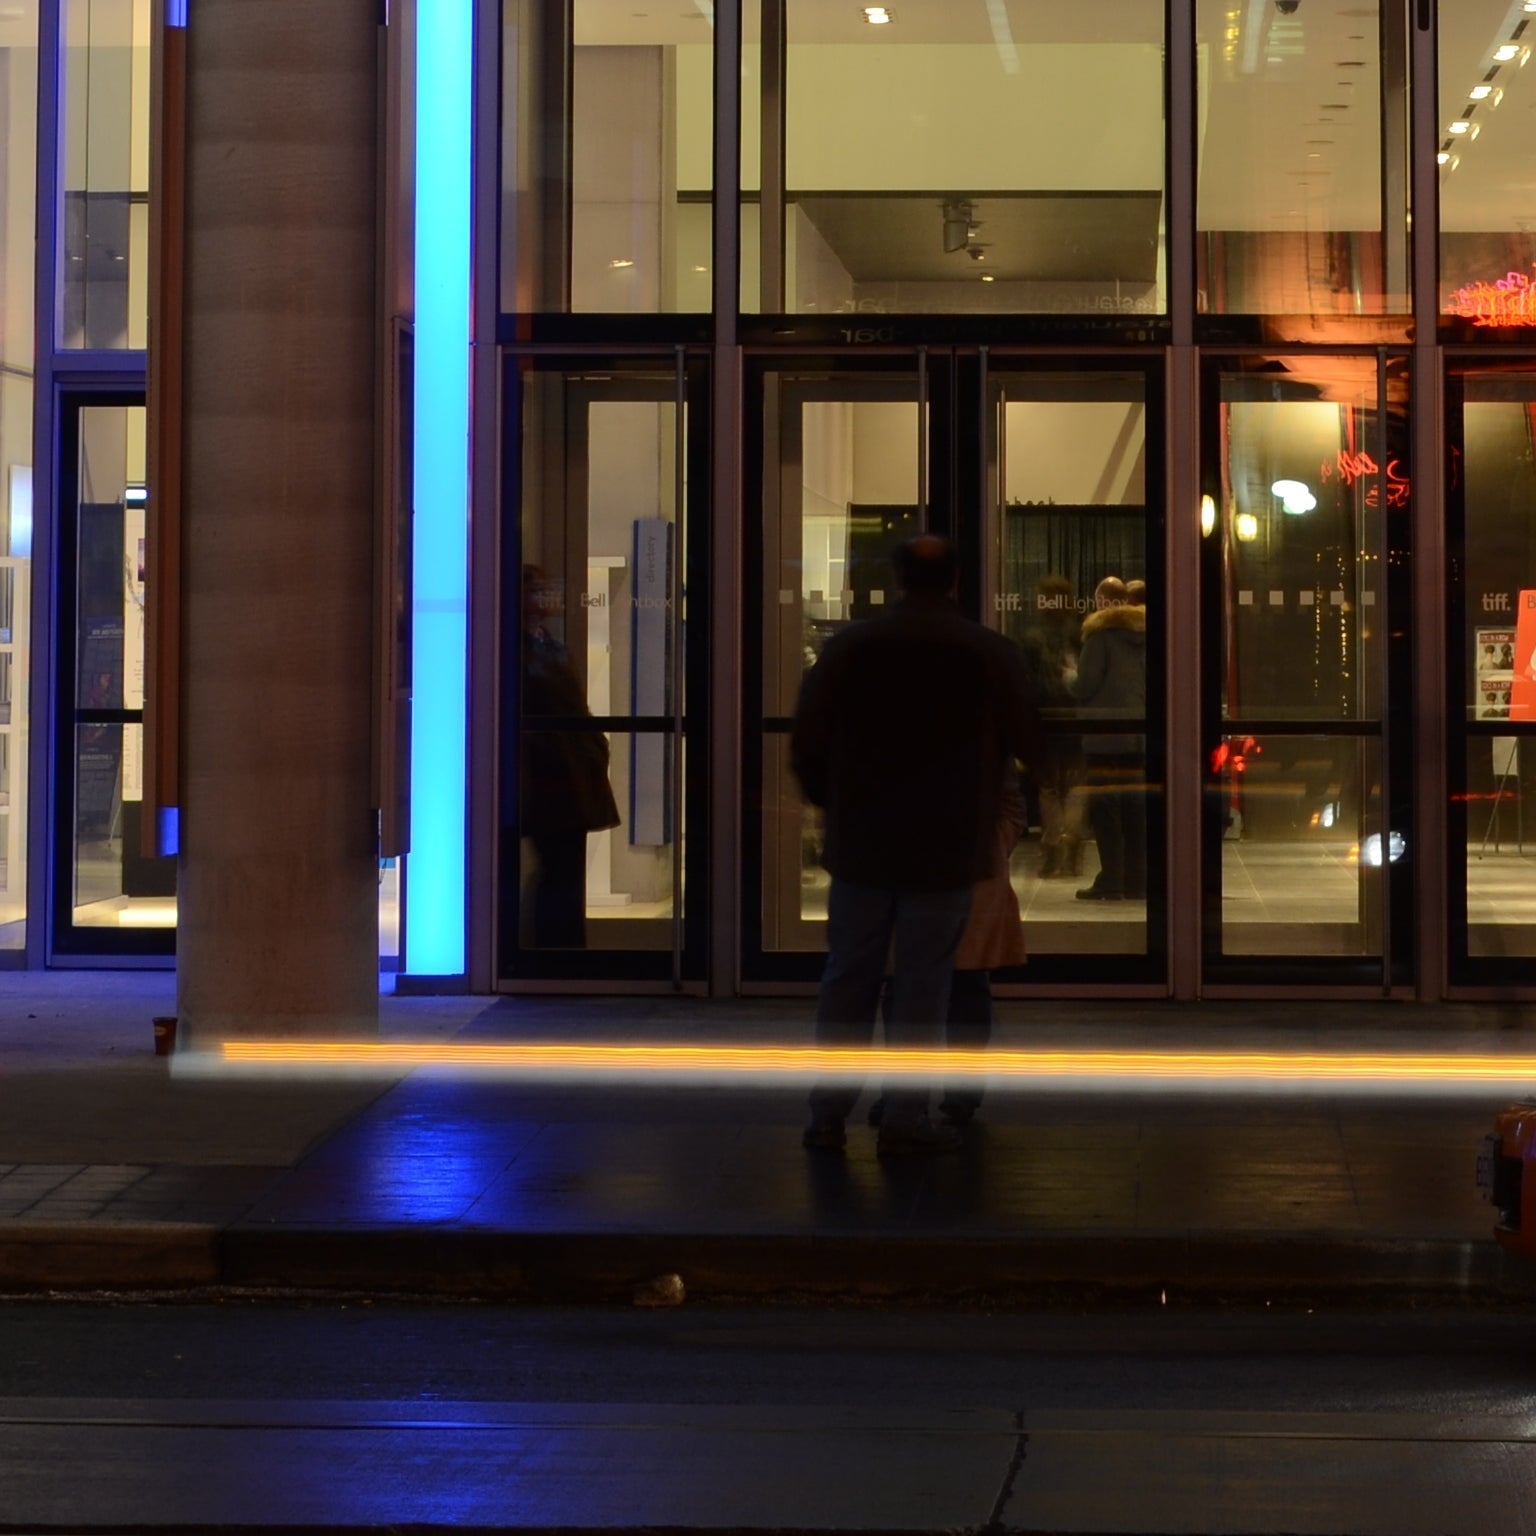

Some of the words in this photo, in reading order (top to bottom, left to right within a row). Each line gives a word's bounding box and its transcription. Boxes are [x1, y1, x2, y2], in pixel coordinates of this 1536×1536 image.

[993, 593, 1022, 611] tiff.
[1037, 594, 1063, 609] Bell
[1064, 594, 1128, 614] Lightbox
[1482, 593, 1511, 611] tiff.
